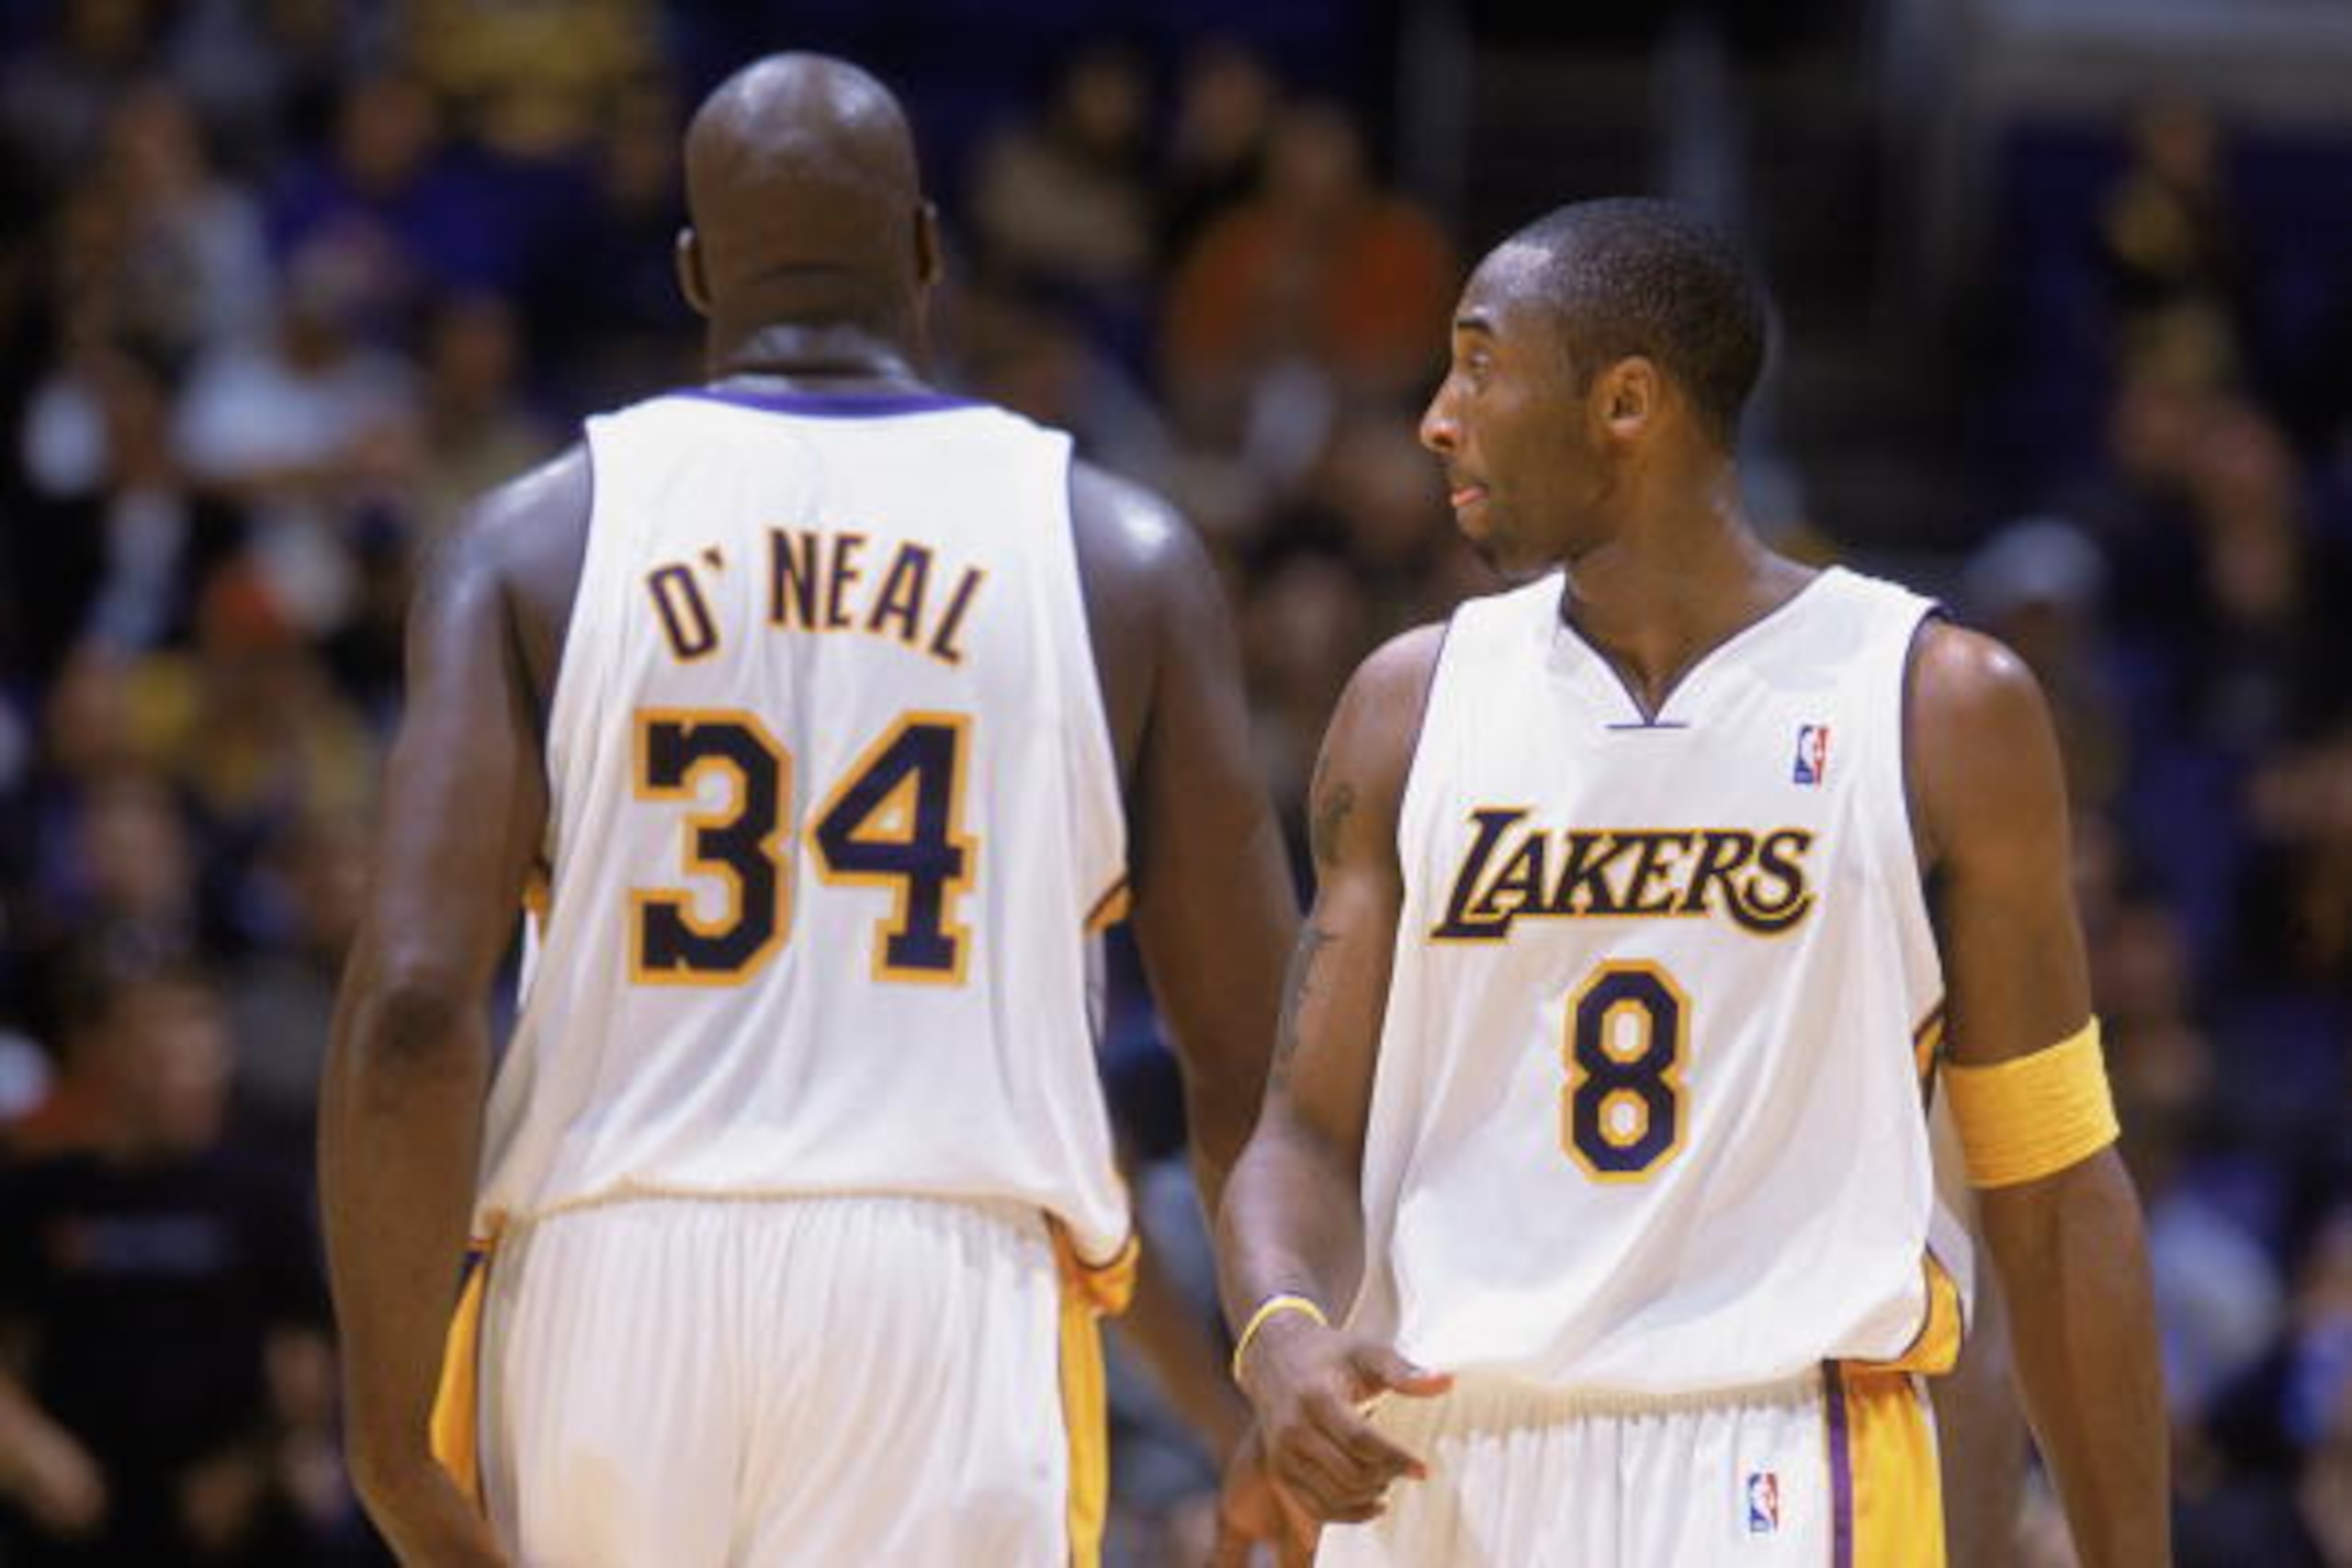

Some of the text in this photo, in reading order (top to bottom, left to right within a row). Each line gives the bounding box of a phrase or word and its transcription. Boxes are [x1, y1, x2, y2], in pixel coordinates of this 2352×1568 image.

[628, 708, 979, 989] 34
[1429, 805, 1817, 945] LAKERS
[1561, 958, 1693, 1184] 8
